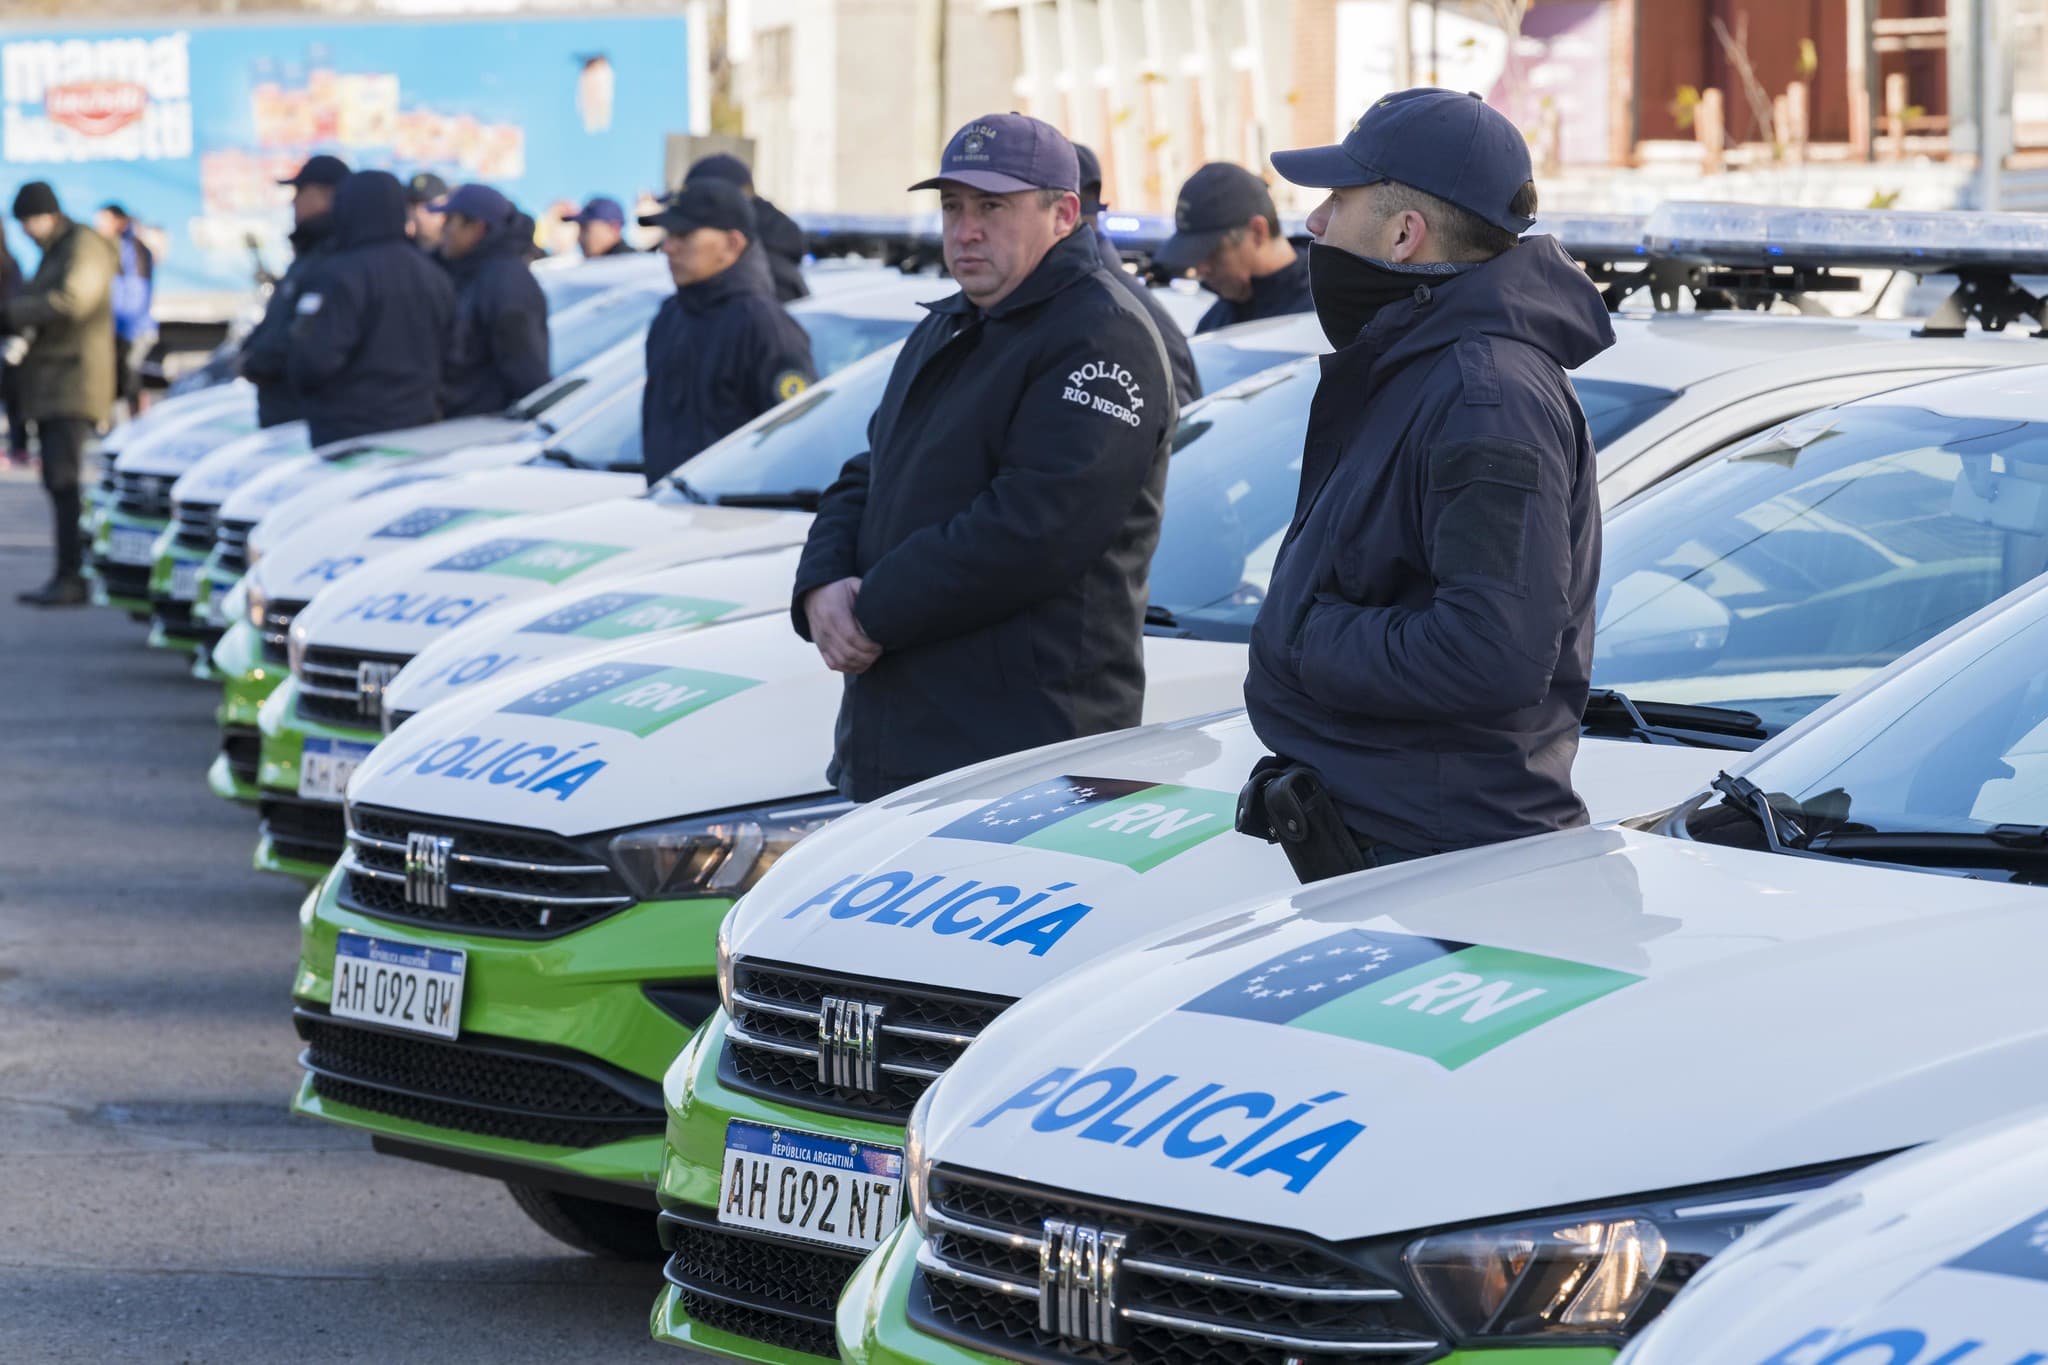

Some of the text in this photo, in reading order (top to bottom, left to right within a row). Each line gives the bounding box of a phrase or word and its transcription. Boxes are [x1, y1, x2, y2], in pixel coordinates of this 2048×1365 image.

[1062, 386, 1141, 427] RIO NEGRO
[1068, 361, 1144, 412] POLICIA
[609, 681, 707, 712] RN
[384, 735, 608, 801] POLICÍA
[1087, 802, 1216, 840] RN
[783, 871, 1094, 957] POLICÍA
[337, 962, 368, 1012] AH
[374, 968, 417, 1021] 092
[1381, 971, 1547, 1024] RN
[817, 996, 884, 1092] FIAT
[771, 1142, 854, 1169] REPÚBLICA ARGENTINA
[970, 1066, 1367, 1194] POLICÍA
[726, 1157, 892, 1242] AH 092 NT
[1038, 1219, 1126, 1345] FIAT
